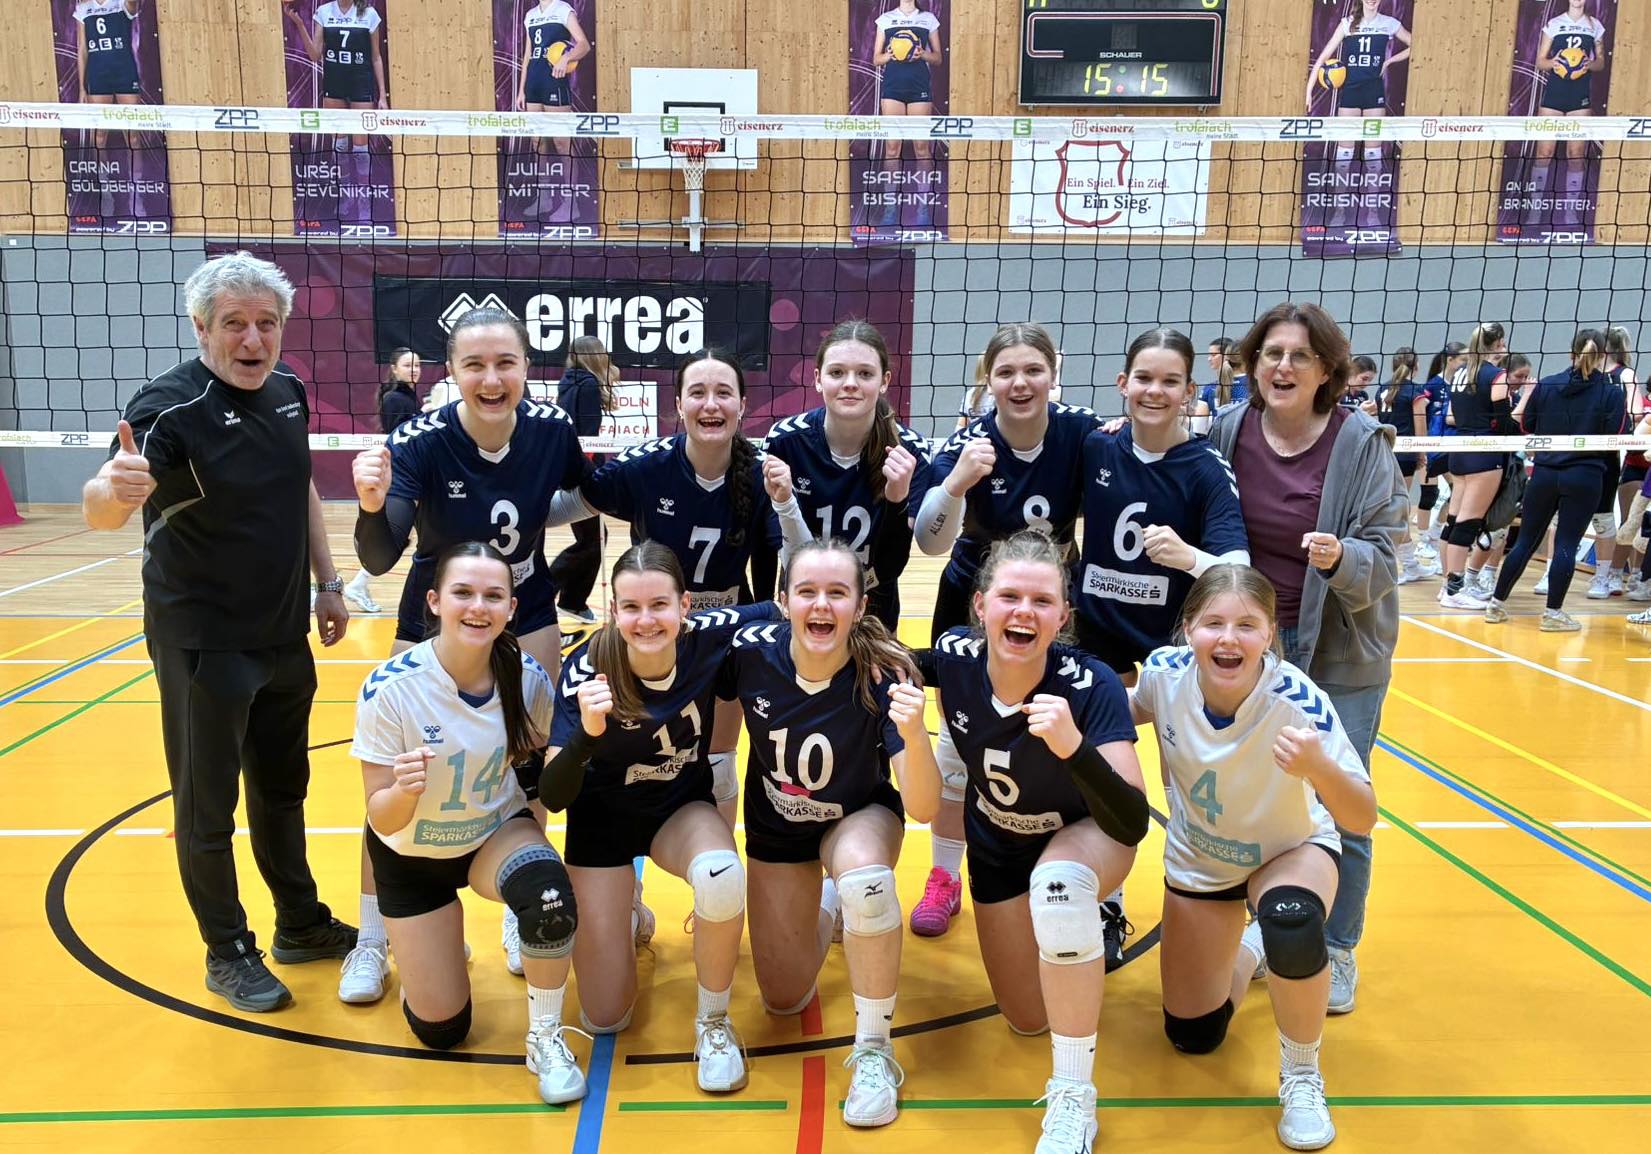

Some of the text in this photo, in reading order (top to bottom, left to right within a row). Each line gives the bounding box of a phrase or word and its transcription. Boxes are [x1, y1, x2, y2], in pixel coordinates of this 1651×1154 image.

[96, 17, 107, 35] 6
[339, 30, 350, 48] 7
[534, 28, 542, 45] 8
[1566, 35, 1582, 49] 12
[1358, 36, 1371, 53] 11
[12, 108, 61, 121] eisenerz
[103, 107, 163, 121] trofaiach
[213, 108, 259, 127] ZPP
[468, 113, 527, 127] trofaiach
[380, 116, 427, 127] eisenerz
[576, 114, 620, 131] ZPP
[737, 121, 784, 131] eisenerz
[824, 117, 881, 131] trofaiach
[930, 117, 973, 134] ZPP
[1088, 122, 1135, 133] eisenerz
[1174, 119, 1232, 133] trofaiach
[1280, 118, 1324, 135] ZPP
[1438, 120, 1484, 132] eisenerz
[1524, 119, 1581, 132] trofaiach
[1627, 118, 1651, 135] ZP
[295, 161, 342, 179] URŠA
[508, 162, 563, 176] JULIA
[862, 170, 942, 184] SASKIA
[1067, 178, 1170, 190] Ein Spiel. Ein Ziel.
[1307, 172, 1393, 187] SANDRA
[71, 179, 165, 194] GOLDBERGER
[296, 180, 389, 199] SEVČNIKAR
[508, 183, 591, 198] MITTER
[1505, 181, 1536, 192] ANJA
[863, 192, 941, 206] BISANZ
[1083, 194, 1152, 213] Ein Sieg.
[1306, 193, 1391, 208] REISNER
[1503, 199, 1591, 210] BRANDSTETTER
[117, 220, 167, 233] ZPP
[341, 224, 390, 237] ZPP
[544, 226, 592, 238] ZPP
[895, 230, 943, 241] ZPP
[1344, 230, 1390, 244] ZPP
[1541, 231, 1588, 244] ZPP
[525, 292, 704, 354] errea
[1449, 367, 1468, 393] 10
[599, 425, 651, 435] FAIACH
[60, 433, 89, 444] ZPP
[1525, 437, 1552, 448] ZPP
[488, 499, 521, 556] 3
[816, 504, 872, 565] 12
[1113, 501, 1148, 562] 6
[688, 525, 722, 584] 7
[1090, 570, 1150, 589] Steiermärkische
[1089, 578, 1150, 599] SPARKASSE
[652, 700, 702, 757] 11
[768, 727, 834, 791] 10
[440, 745, 505, 812] 14
[983, 747, 1020, 807] 5
[1189, 769, 1224, 827] 4
[421, 829, 481, 842] SPARKAS
[542, 899, 564, 912] errea
[1046, 894, 1069, 903] errea
